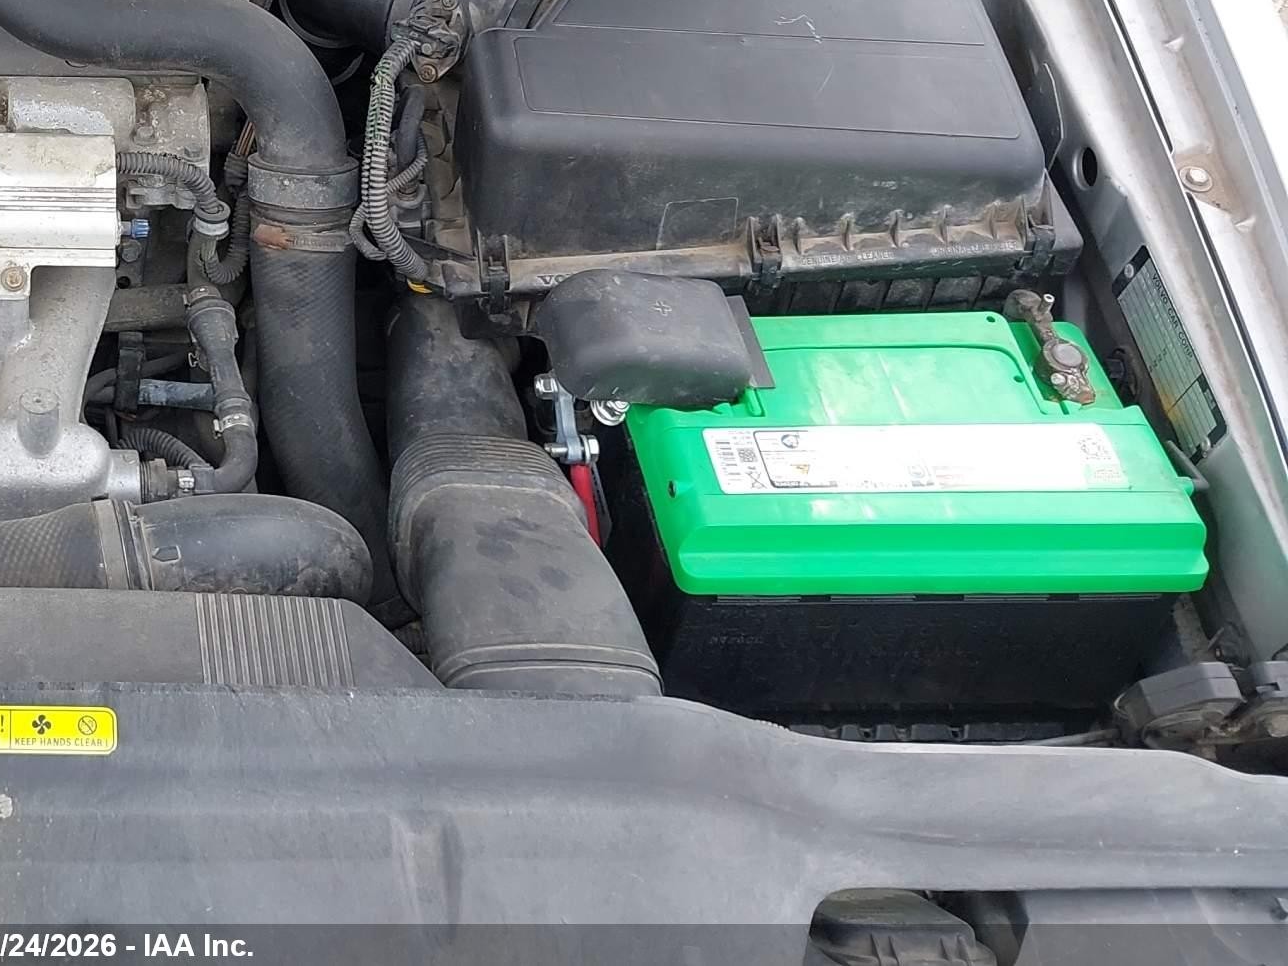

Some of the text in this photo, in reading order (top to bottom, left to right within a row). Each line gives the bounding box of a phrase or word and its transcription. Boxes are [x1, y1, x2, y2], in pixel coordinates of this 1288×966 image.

[1151, 273, 1169, 306] VOLVO
[1167, 307, 1179, 330] CAR
[0, 714, 4, 732] !
[14, 738, 37, 746] KEEP
[40, 738, 72, 747] HANDS
[74, 739, 103, 747] CLEAR
